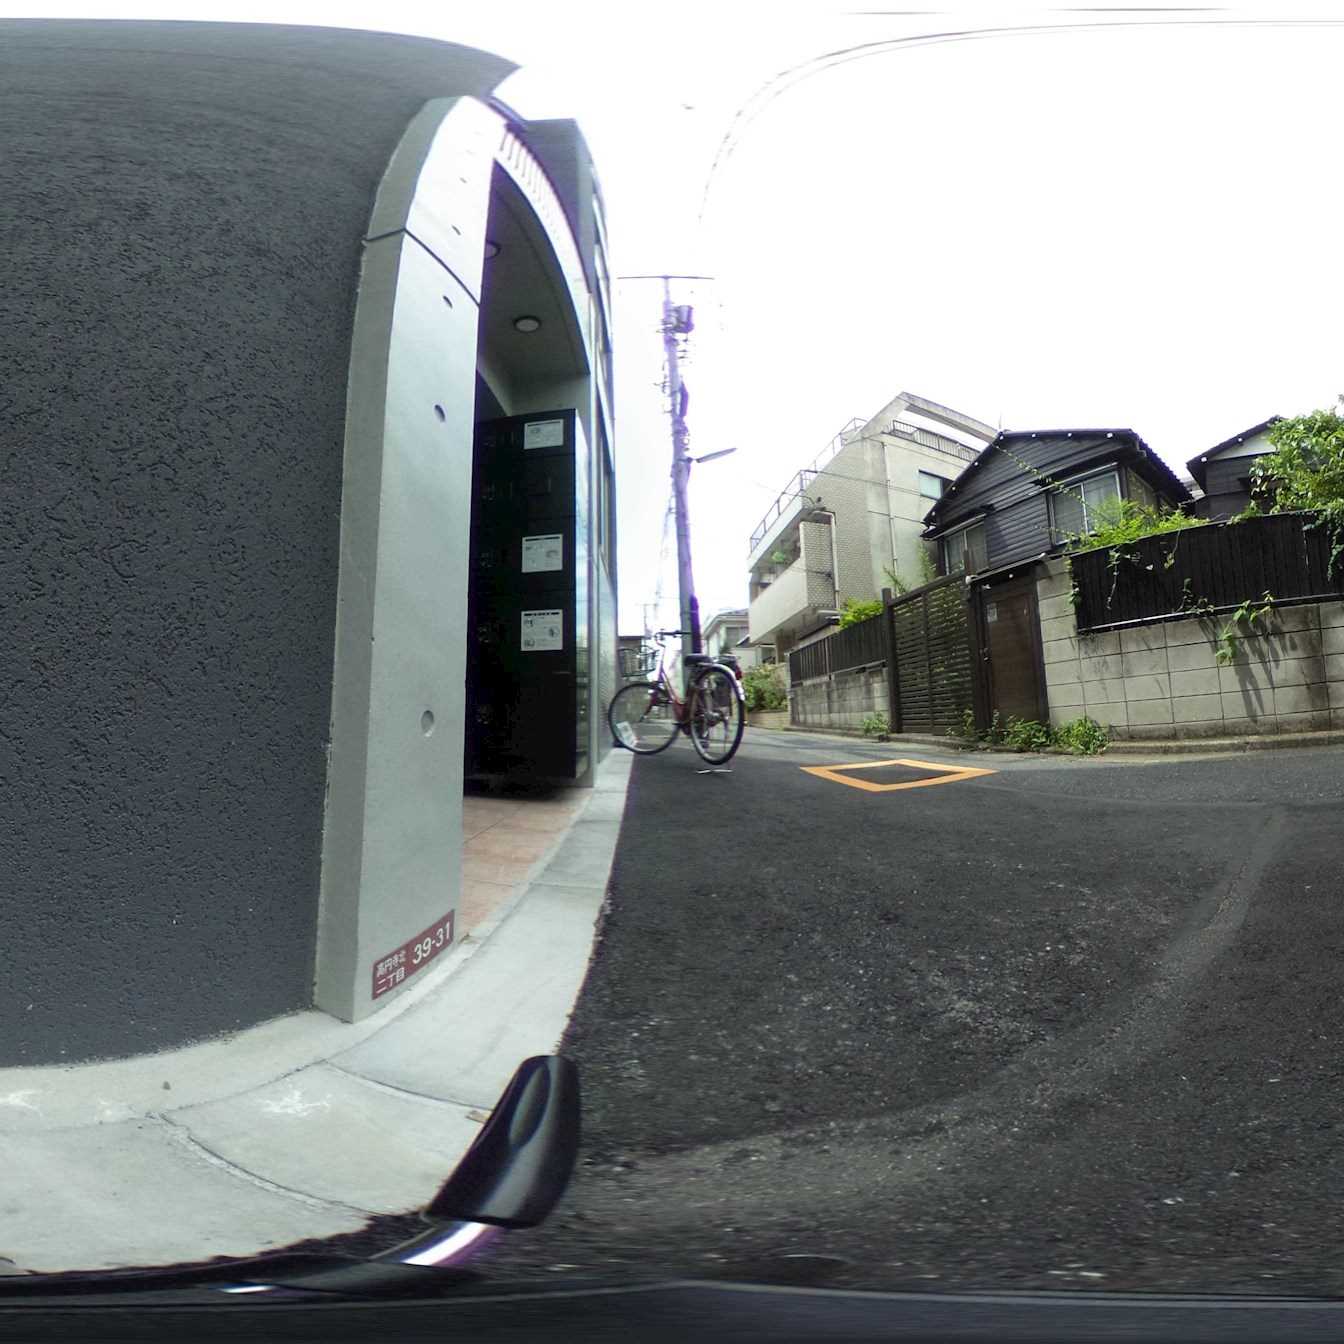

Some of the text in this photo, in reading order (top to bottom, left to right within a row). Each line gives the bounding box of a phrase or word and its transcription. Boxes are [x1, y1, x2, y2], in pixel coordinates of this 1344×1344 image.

[412, 921, 450, 965] 39-31
[375, 967, 405, 994] 二丁目
